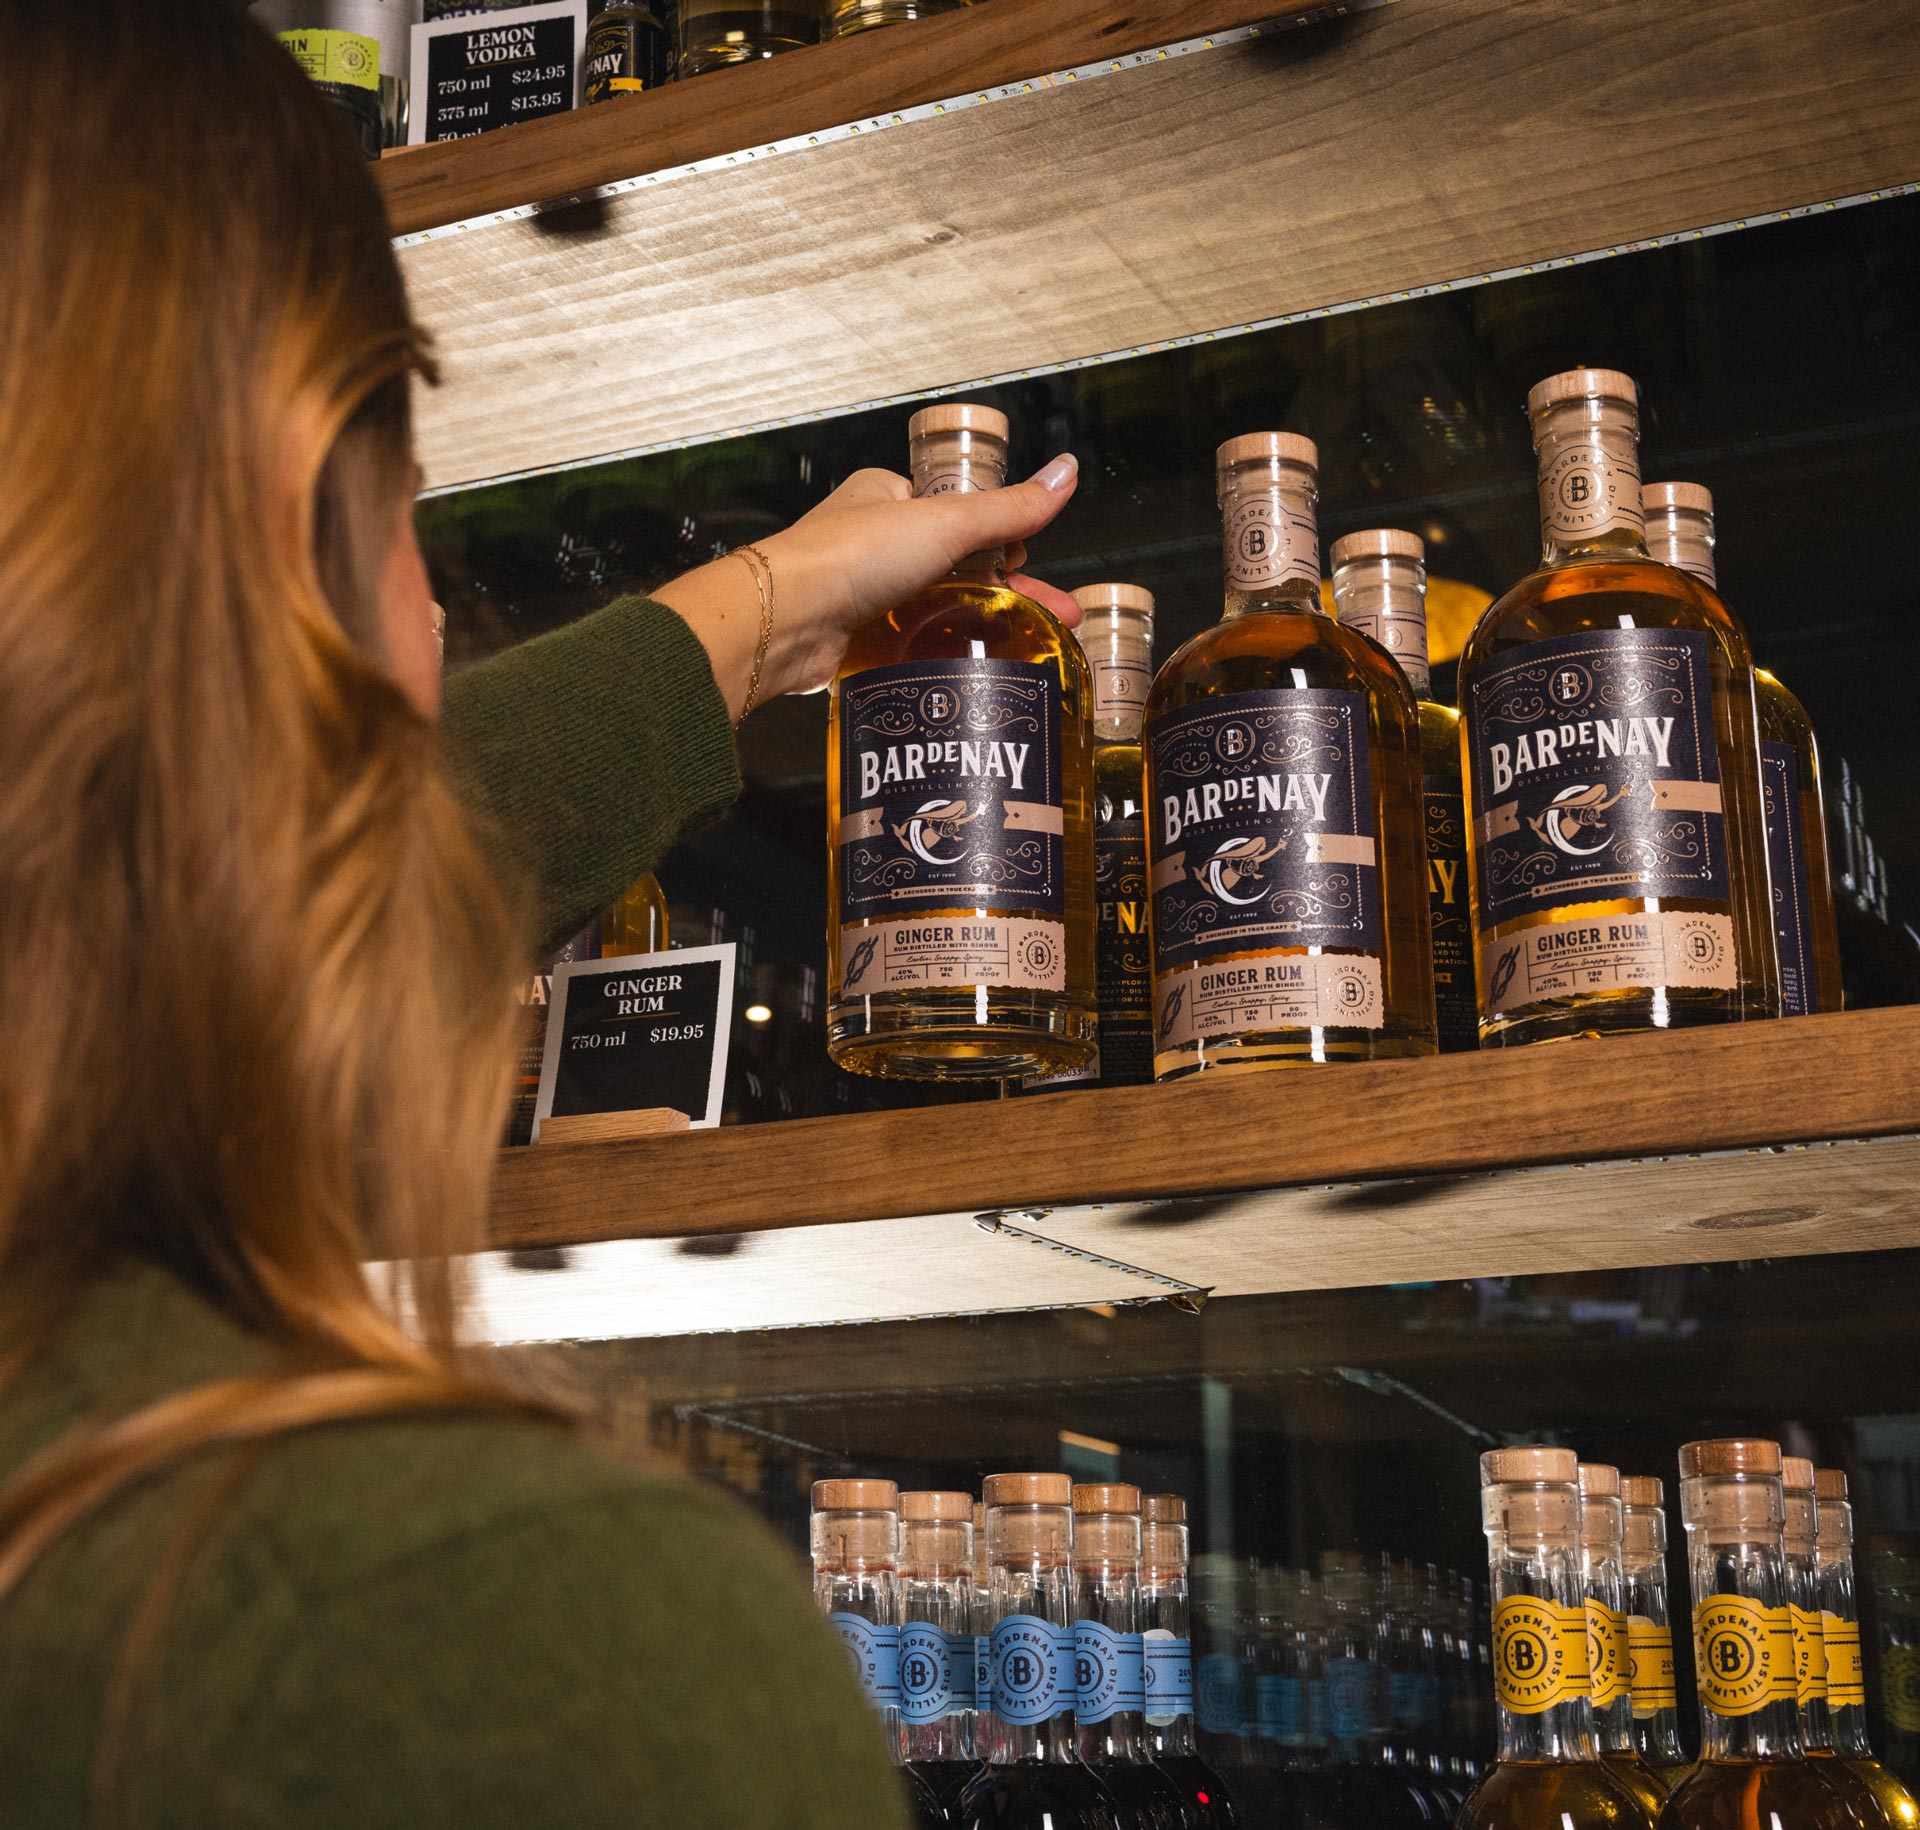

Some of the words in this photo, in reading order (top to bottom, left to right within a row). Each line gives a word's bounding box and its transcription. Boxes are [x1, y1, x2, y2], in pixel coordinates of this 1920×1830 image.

[467, 26, 536, 50] LEMON
[465, 43, 536, 65] VODKA
[590, 53, 623, 75] NAY
[438, 78, 467, 96] 750
[471, 75, 491, 91] ml
[512, 65, 566, 85] $24.95
[438, 106, 465, 122] 375
[469, 102, 489, 118] ml
[1570, 475, 1589, 502] B
[1249, 529, 1265, 555] B
[1490, 717, 1675, 795] BARDENAY
[860, 741, 1029, 799] BARDENAY
[1518, 764, 1614, 786] DISTILLING
[1163, 773, 1332, 845] BARDENAY
[1185, 816, 1272, 838] DISTILLING
[1544, 882, 1579, 892] ANCHORED
[896, 927, 954, 944] GINGER
[961, 927, 995, 940] RUM
[1019, 930, 1056, 949] BARDENAY
[1206, 930, 1237, 939] ANCHORED
[1538, 928, 1601, 951] GINGER
[1609, 924, 1649, 941] RUM
[1554, 945, 1593, 956] DISTILLED
[1613, 954, 1636, 963] Spicy
[1023, 955, 1059, 980] DISTILLING
[1201, 969, 1258, 990] GINGER
[1265, 965, 1302, 982] RUM
[603, 975, 682, 998] GINGER
[1215, 986, 1251, 997] DISTILLED
[1269, 994, 1290, 1002] Spicy
[1535, 982, 1567, 992] ALC/VOL
[617, 996, 664, 1015] RUM
[650, 1024, 704, 1043] $19.95
[1198, 1020, 1226, 1029] ALC/VOL
[571, 1034, 601, 1050] 750
[604, 1032, 626, 1047] ml
[1497, 1614, 1559, 1645] BARDENAY
[1699, 1615, 1765, 1645] BARDENAY
[995, 1632, 1054, 1660] BARDENAY
[1514, 1639, 1534, 1671] B
[1719, 1639, 1741, 1673] B
[910, 1660, 926, 1687] B
[1013, 1655, 1031, 1686] B
[1077, 1658, 1092, 1686] B
[1502, 1650, 1563, 1696] DISTILLING
[1707, 1652, 1770, 1698] DISTILLING
[998, 1666, 1057, 1709] DISTILLING
